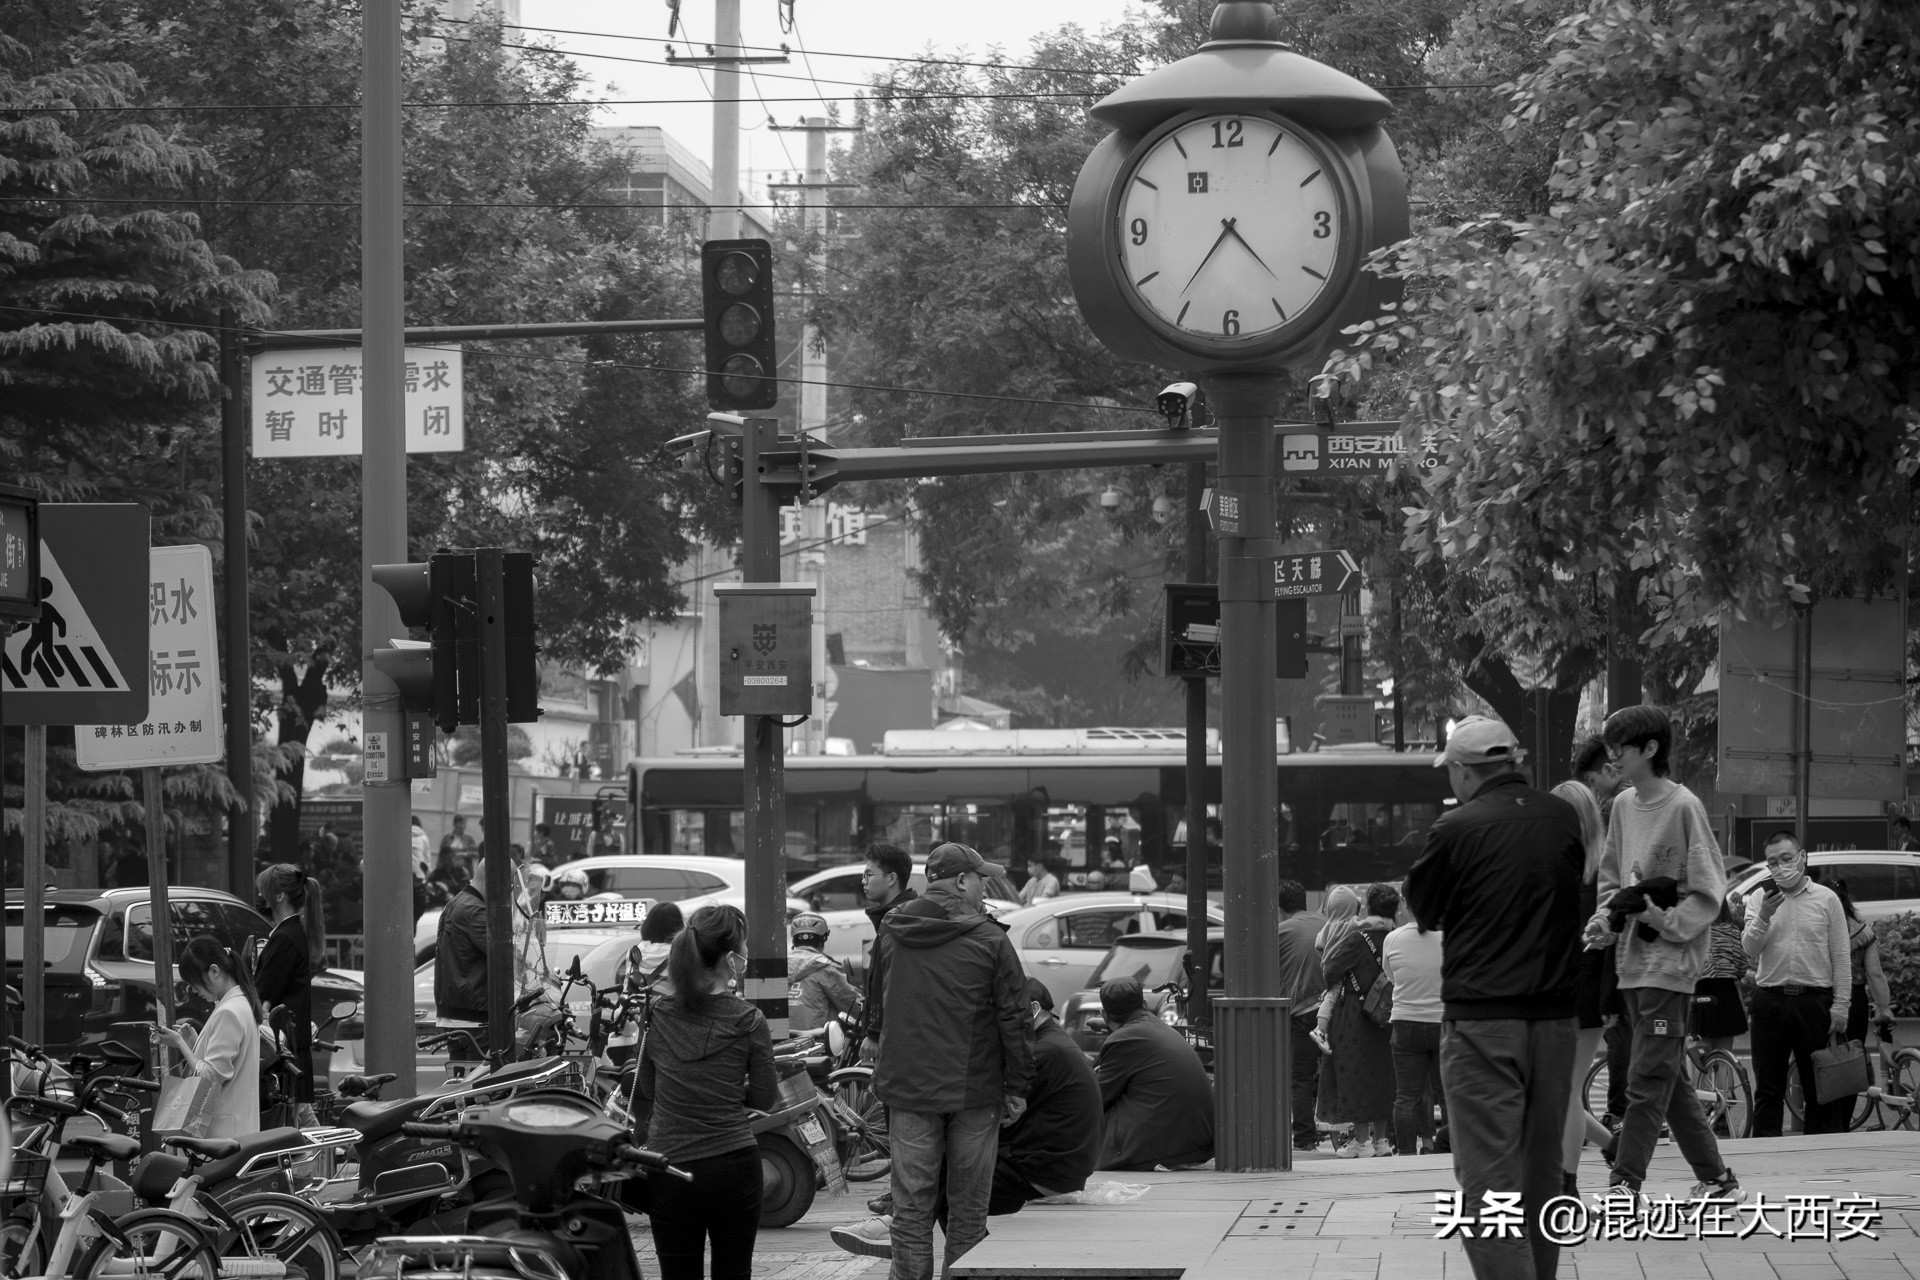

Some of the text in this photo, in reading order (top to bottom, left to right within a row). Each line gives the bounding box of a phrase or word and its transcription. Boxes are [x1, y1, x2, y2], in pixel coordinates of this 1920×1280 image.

[1211, 119, 1244, 149] 12
[1130, 218, 1148, 246] 9
[1312, 210, 1332, 239] 3
[1222, 309, 1240, 337] 6
[265, 360, 451, 397] 交通管需求
[265, 405, 451, 441] 暂时闭
[1328, 458, 1371, 469] XI'AN
[1273, 556, 1322, 583] 飞天梯
[1274, 583, 1323, 597] FLYING ESCALATOR
[743, 659, 788, 671] 平安西安
[94, 719, 203, 739] 碑林区防汛办制
[411, 721, 421, 763] 西安碑林
